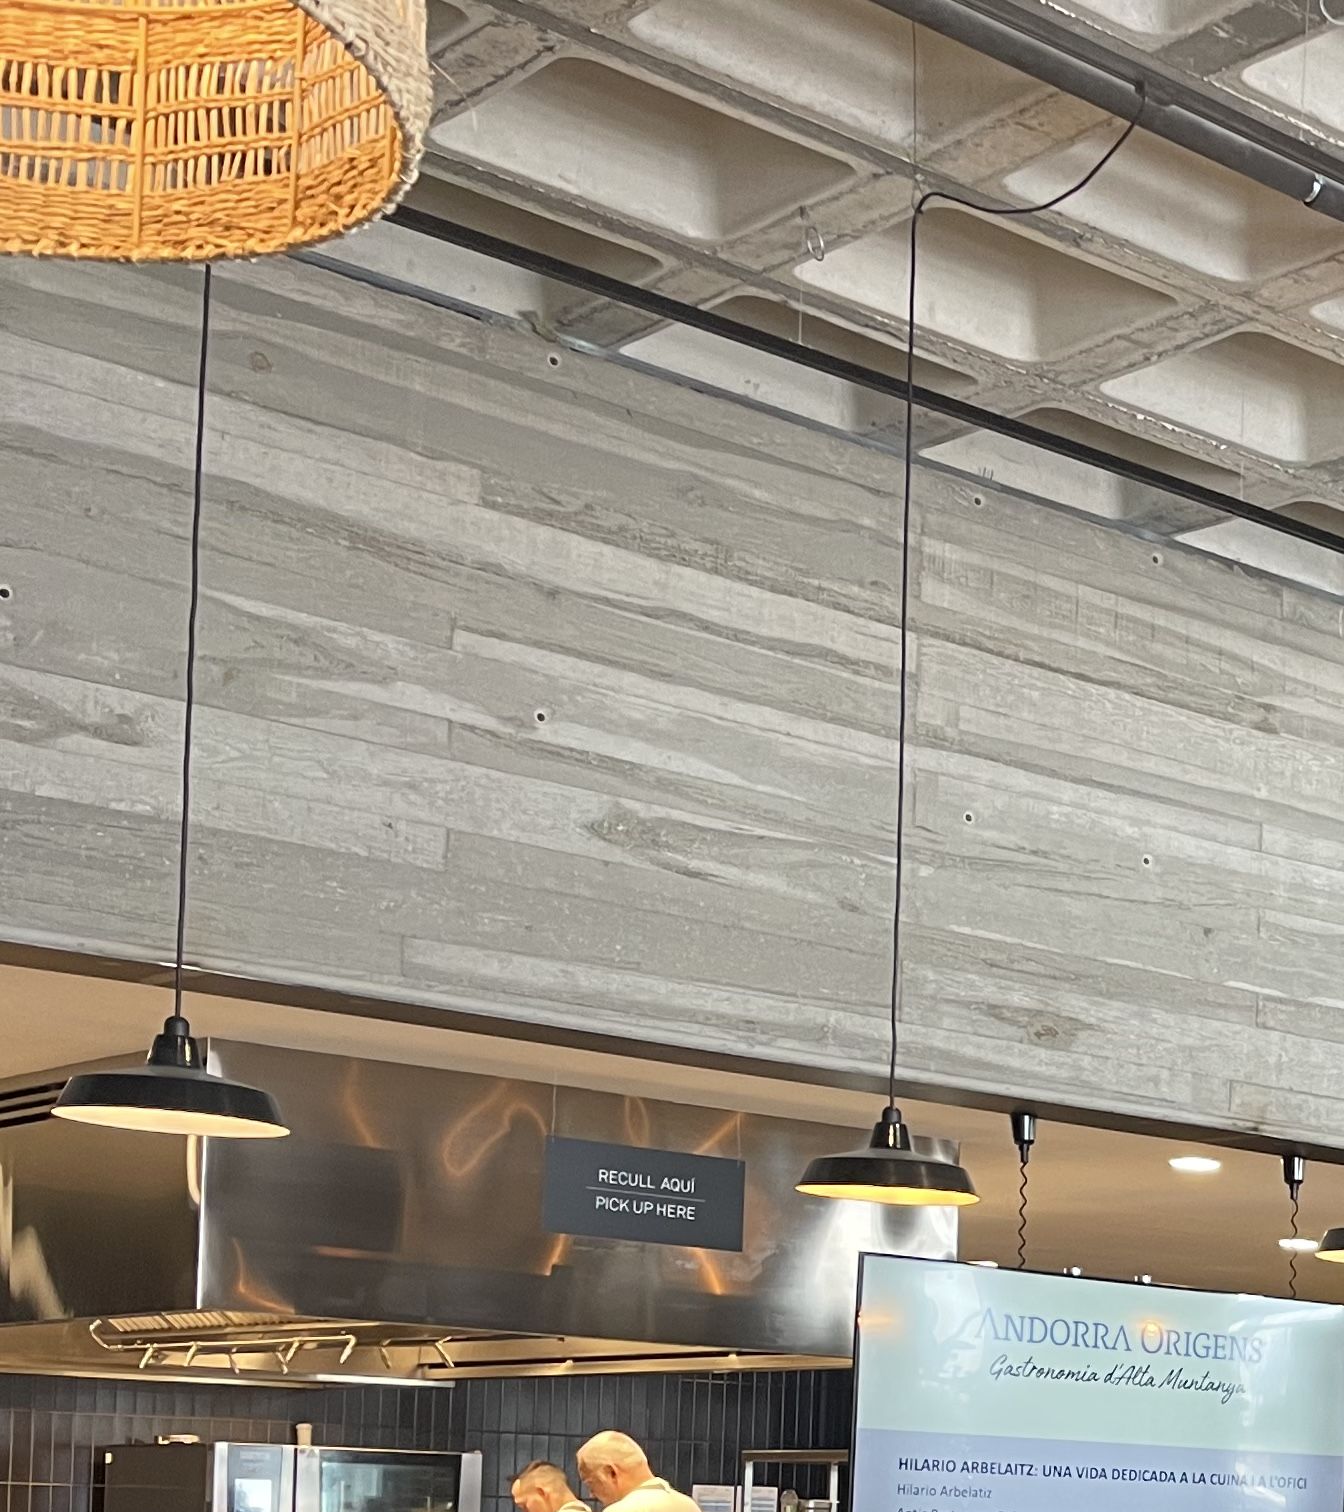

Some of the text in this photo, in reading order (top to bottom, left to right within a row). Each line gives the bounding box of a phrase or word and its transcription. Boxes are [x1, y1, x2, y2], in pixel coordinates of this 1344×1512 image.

[598, 1168, 696, 1193] RECULL AQUÍ
[595, 1196, 696, 1220] PICK UP HERE
[975, 1307, 1263, 1363] ANDORRA ORIGENS
[989, 1354, 1246, 1404] Gastronomia d'Alta Muntanya
[898, 1457, 957, 1473] HILARIO
[960, 1460, 1039, 1476] ARBELAITZ:
[1042, 1465, 1072, 1478] UNA
[1076, 1466, 1108, 1480] VIDA
[1111, 1468, 1176, 1483] DEDICADA
[1179, 1472, 1189, 1484] A
[1192, 1472, 1206, 1485] LA
[1209, 1473, 1248, 1487] CUINA
[1256, 1475, 1267, 1488] A
[1269, 1476, 1308, 1490] L'OFICI
[897, 1484, 937, 1497] Hilario
